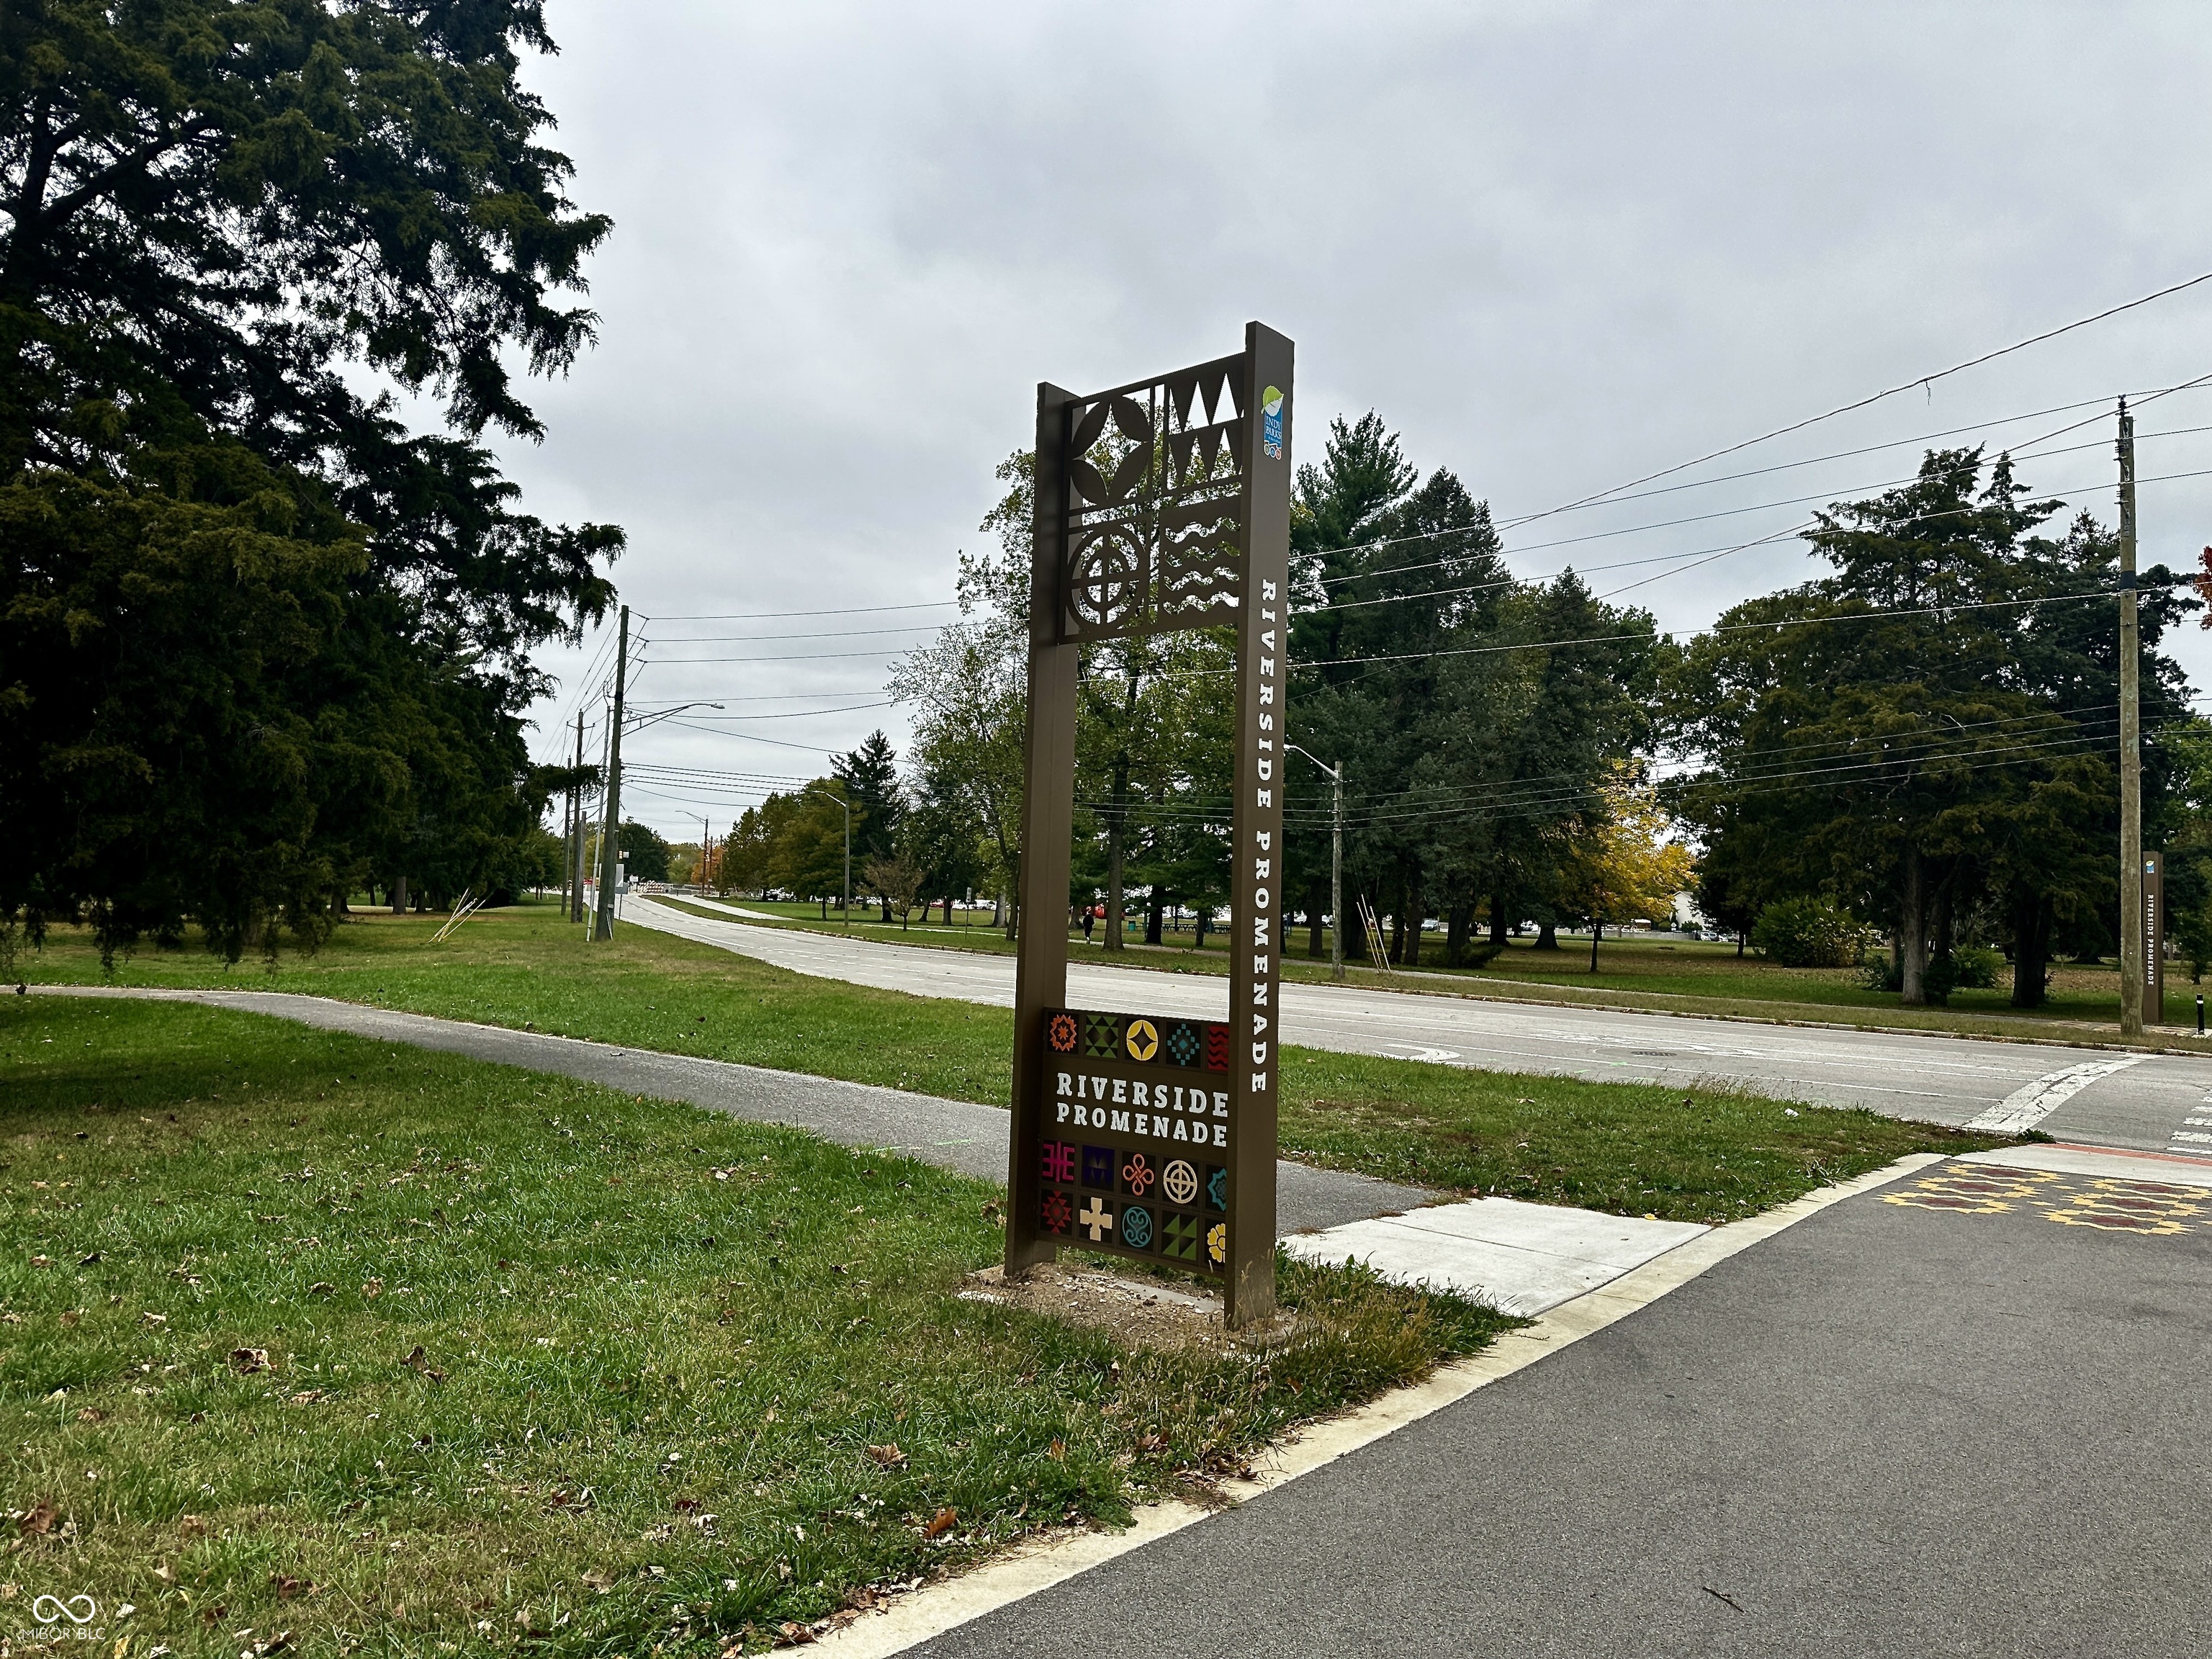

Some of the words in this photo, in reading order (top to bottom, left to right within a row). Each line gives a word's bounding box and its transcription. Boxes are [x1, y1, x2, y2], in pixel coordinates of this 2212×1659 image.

[1266, 415, 1281, 431] INDY
[1266, 426, 1282, 439] PARKS
[1257, 578, 1277, 809] RIVERSIDE
[1251, 830, 1271, 1092] PROMENADE
[1056, 1072, 1228, 1118] RIVERSIDE
[1056, 1102, 1228, 1147] PROMENADE
